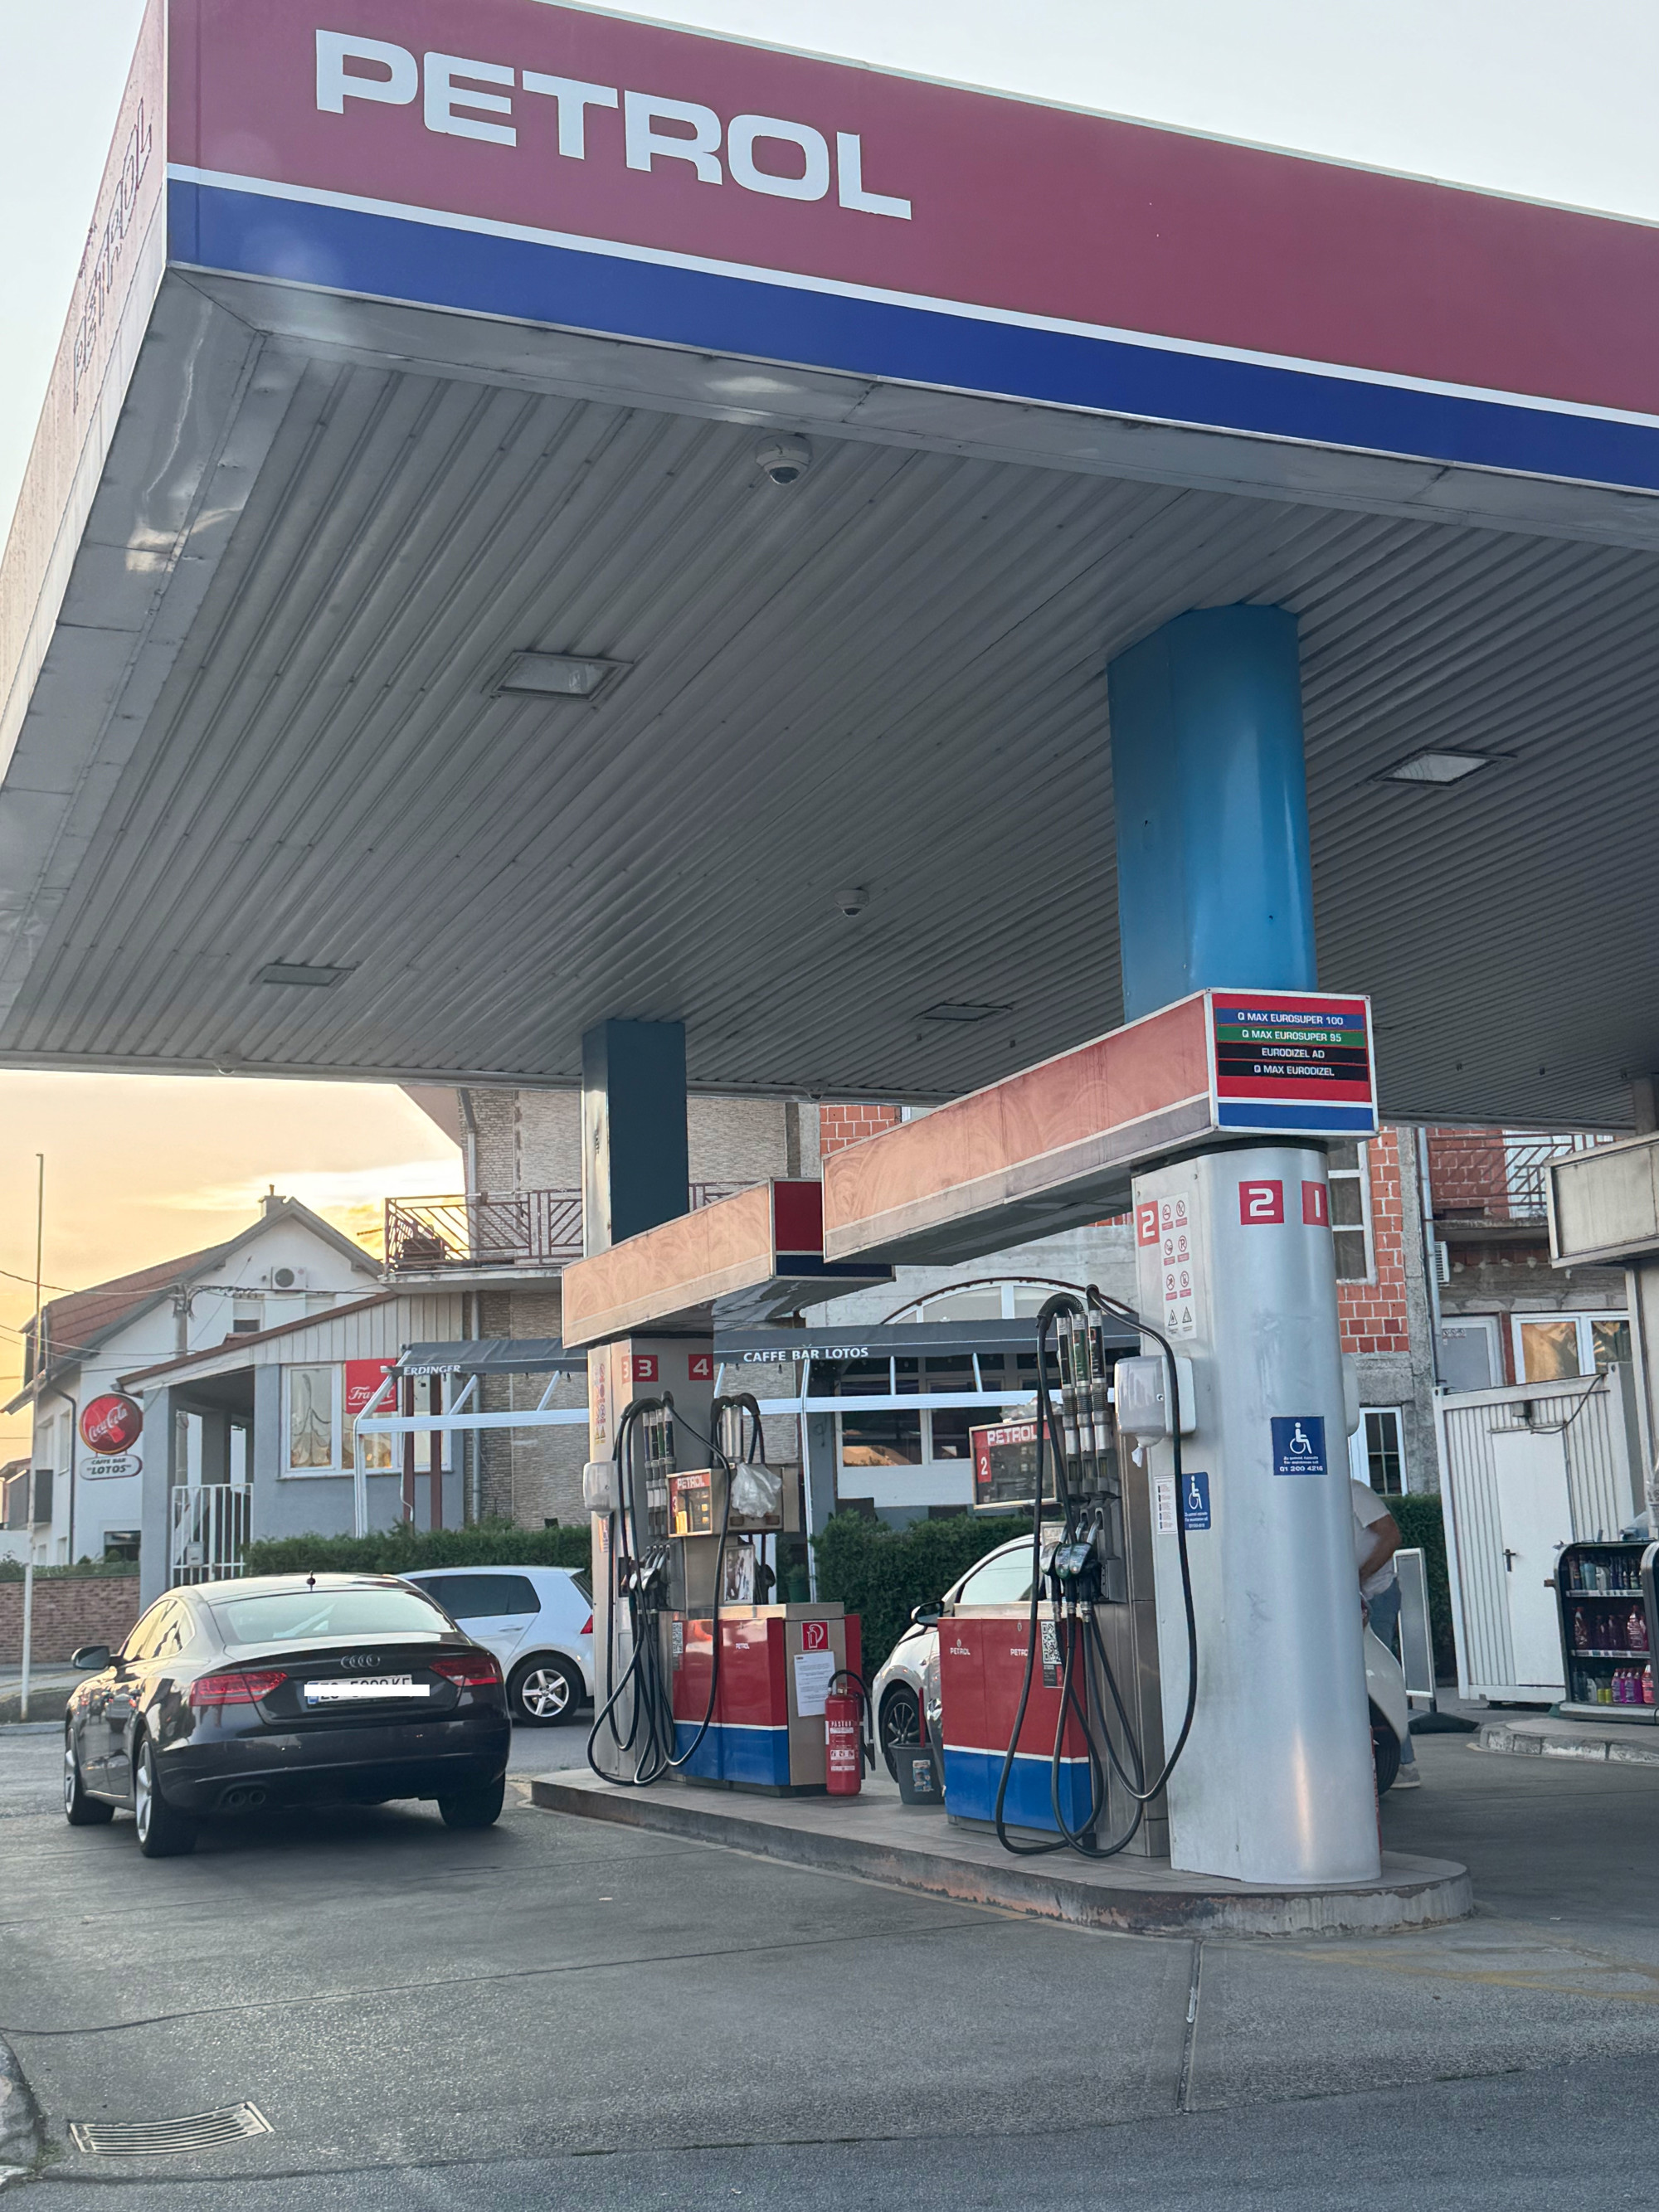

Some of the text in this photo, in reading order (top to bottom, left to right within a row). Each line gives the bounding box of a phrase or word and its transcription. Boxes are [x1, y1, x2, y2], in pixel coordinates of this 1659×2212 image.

[315, 29, 912, 220] PETROL
[1247, 1013, 1268, 1022] MAX
[1270, 1014, 1323, 1025] EUROSUPER
[1326, 1016, 1344, 1026] 100
[1251, 1030, 1272, 1040] MAX
[1275, 1031, 1327, 1042] EUROSUPER
[1330, 1033, 1341, 1043] 95
[1262, 1048, 1325, 1059] EURODIZEL AD
[1263, 1065, 1285, 1074] MAX
[1287, 1066, 1335, 1077] EURODIZEL
[1248, 1188, 1275, 1217] 2
[1314, 1189, 1321, 1218] 1
[1141, 1210, 1155, 1239] 2
[743, 1347, 869, 1363] CAFFE BAR LOTOS
[403, 1364, 461, 1376] ERDINGER
[638, 1359, 653, 1378] 3
[693, 1358, 709, 1376] 4
[987, 1424, 1038, 1446] PETROL
[980, 1456, 988, 1475] 2
[677, 1475, 705, 1490] PETROL
[950, 1647, 971, 1655] PETROL
[1010, 1648, 1029, 1657] PETRO
